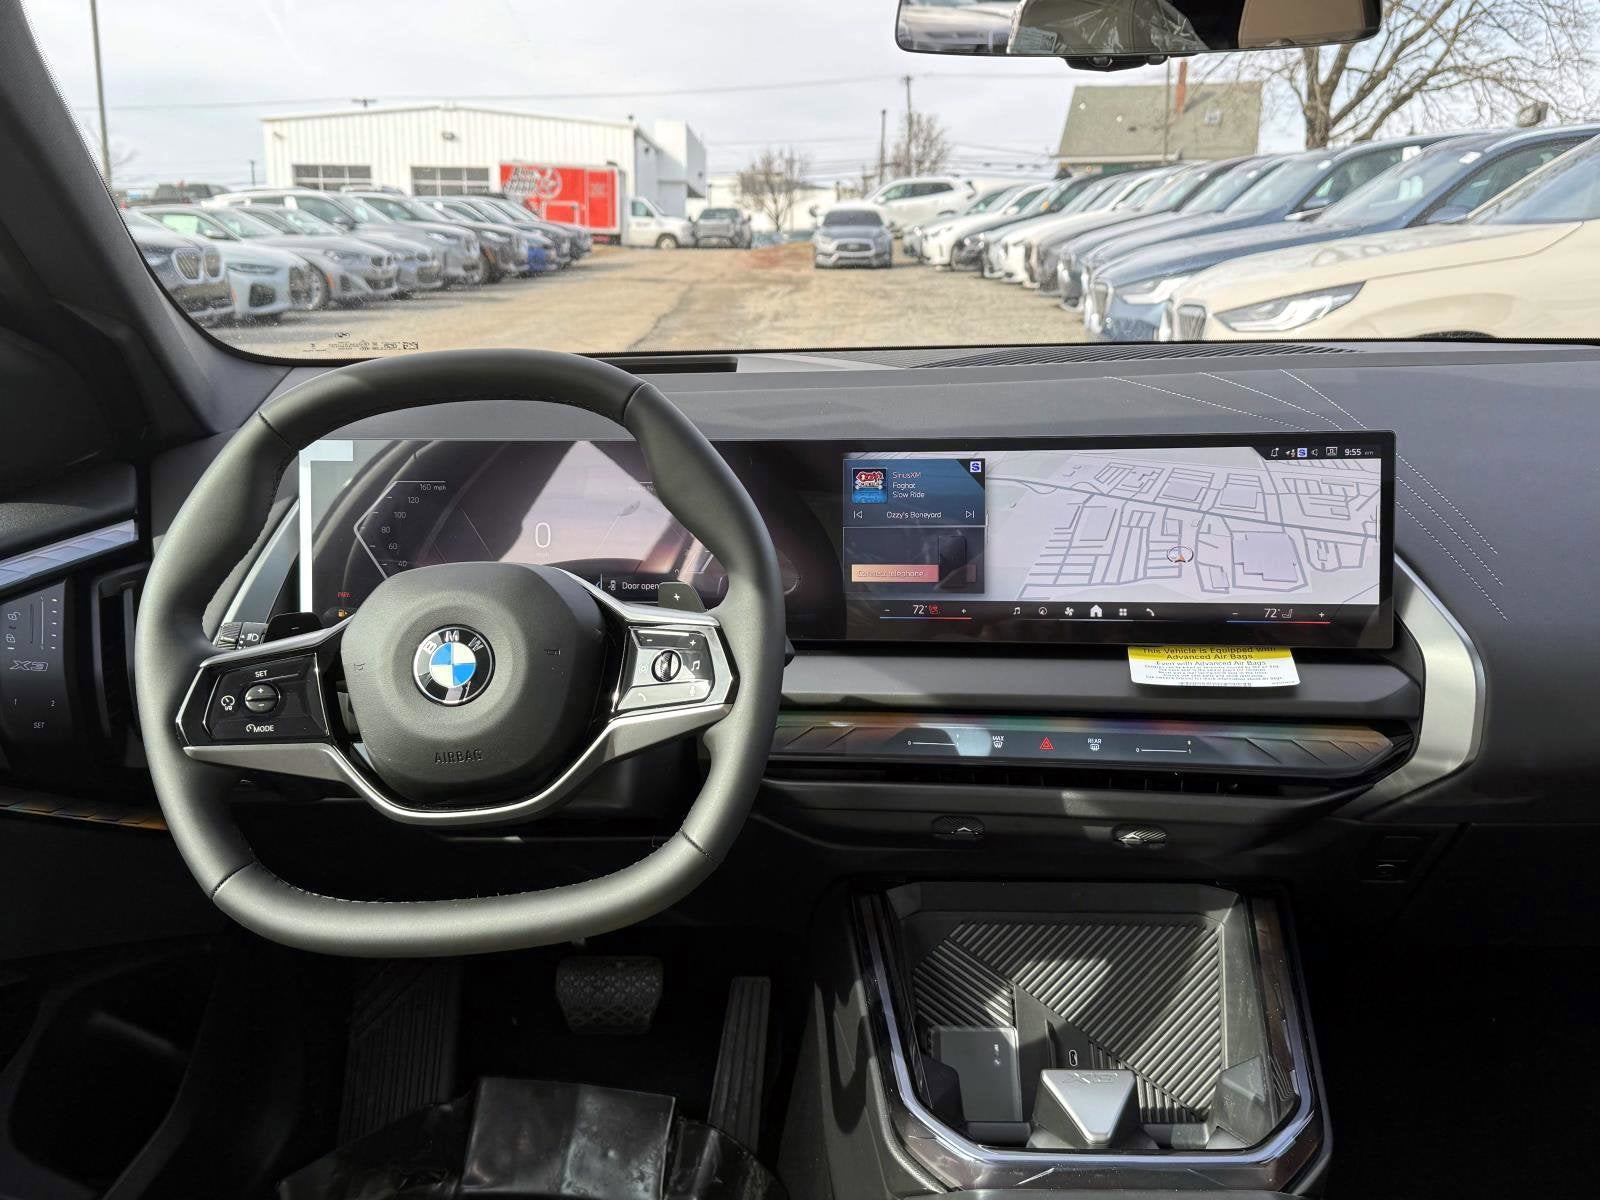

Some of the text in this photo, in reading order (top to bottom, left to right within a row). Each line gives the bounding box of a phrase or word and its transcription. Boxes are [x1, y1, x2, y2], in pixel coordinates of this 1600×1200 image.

[1344, 448, 1362, 456] 9:55
[892, 471, 922, 479] SiriusXM
[419, 483, 432, 491] 160
[892, 481, 916, 491] Foghat
[892, 491, 926, 499] Slow Ride
[407, 496, 420, 504] 120
[394, 511, 407, 519] 100
[886, 511, 942, 520] Ozzy's Boneyard
[381, 526, 391, 534] 80
[534, 522, 551, 548] 0
[621, 581, 660, 592] Door open
[422, 630, 484, 654] BMW
[1230, 653, 1253, 661] Bags
[9, 660, 49, 672] X3
[254, 670, 268, 678] SET
[253, 724, 275, 733] MODE
[433, 749, 483, 764] AIRBAG
